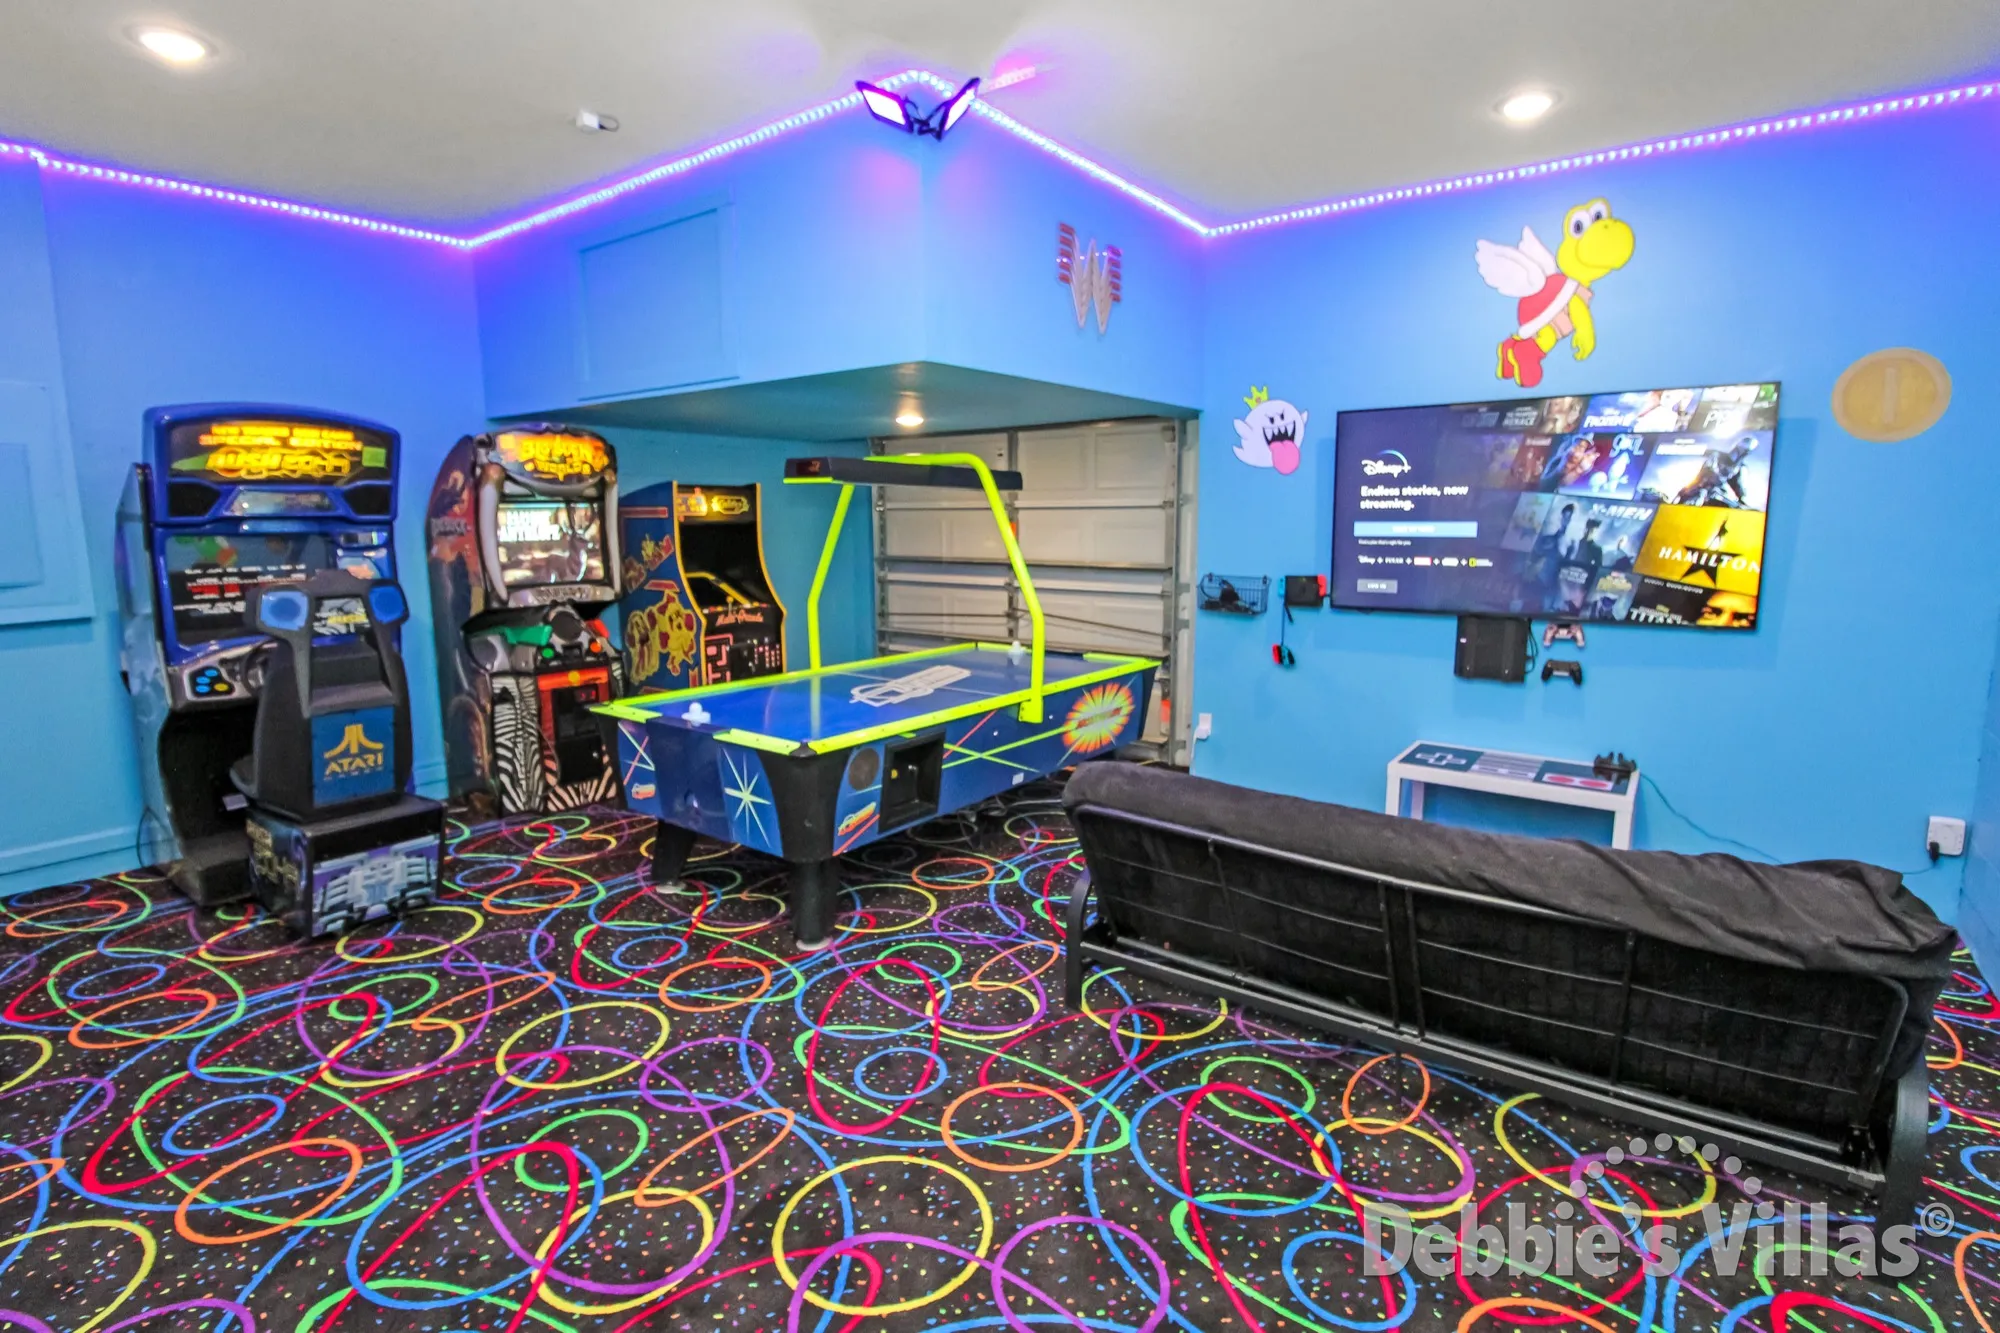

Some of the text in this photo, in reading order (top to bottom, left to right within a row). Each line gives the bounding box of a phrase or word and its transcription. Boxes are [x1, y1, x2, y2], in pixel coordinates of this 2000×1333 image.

[1361, 484, 1469, 497] Endless stories, now
[1360, 498, 1415, 511] streaming.
[1592, 503, 1653, 520] X-MEN
[1659, 546, 1760, 574] HAMILTON
[324, 752, 384, 776] ATARI
